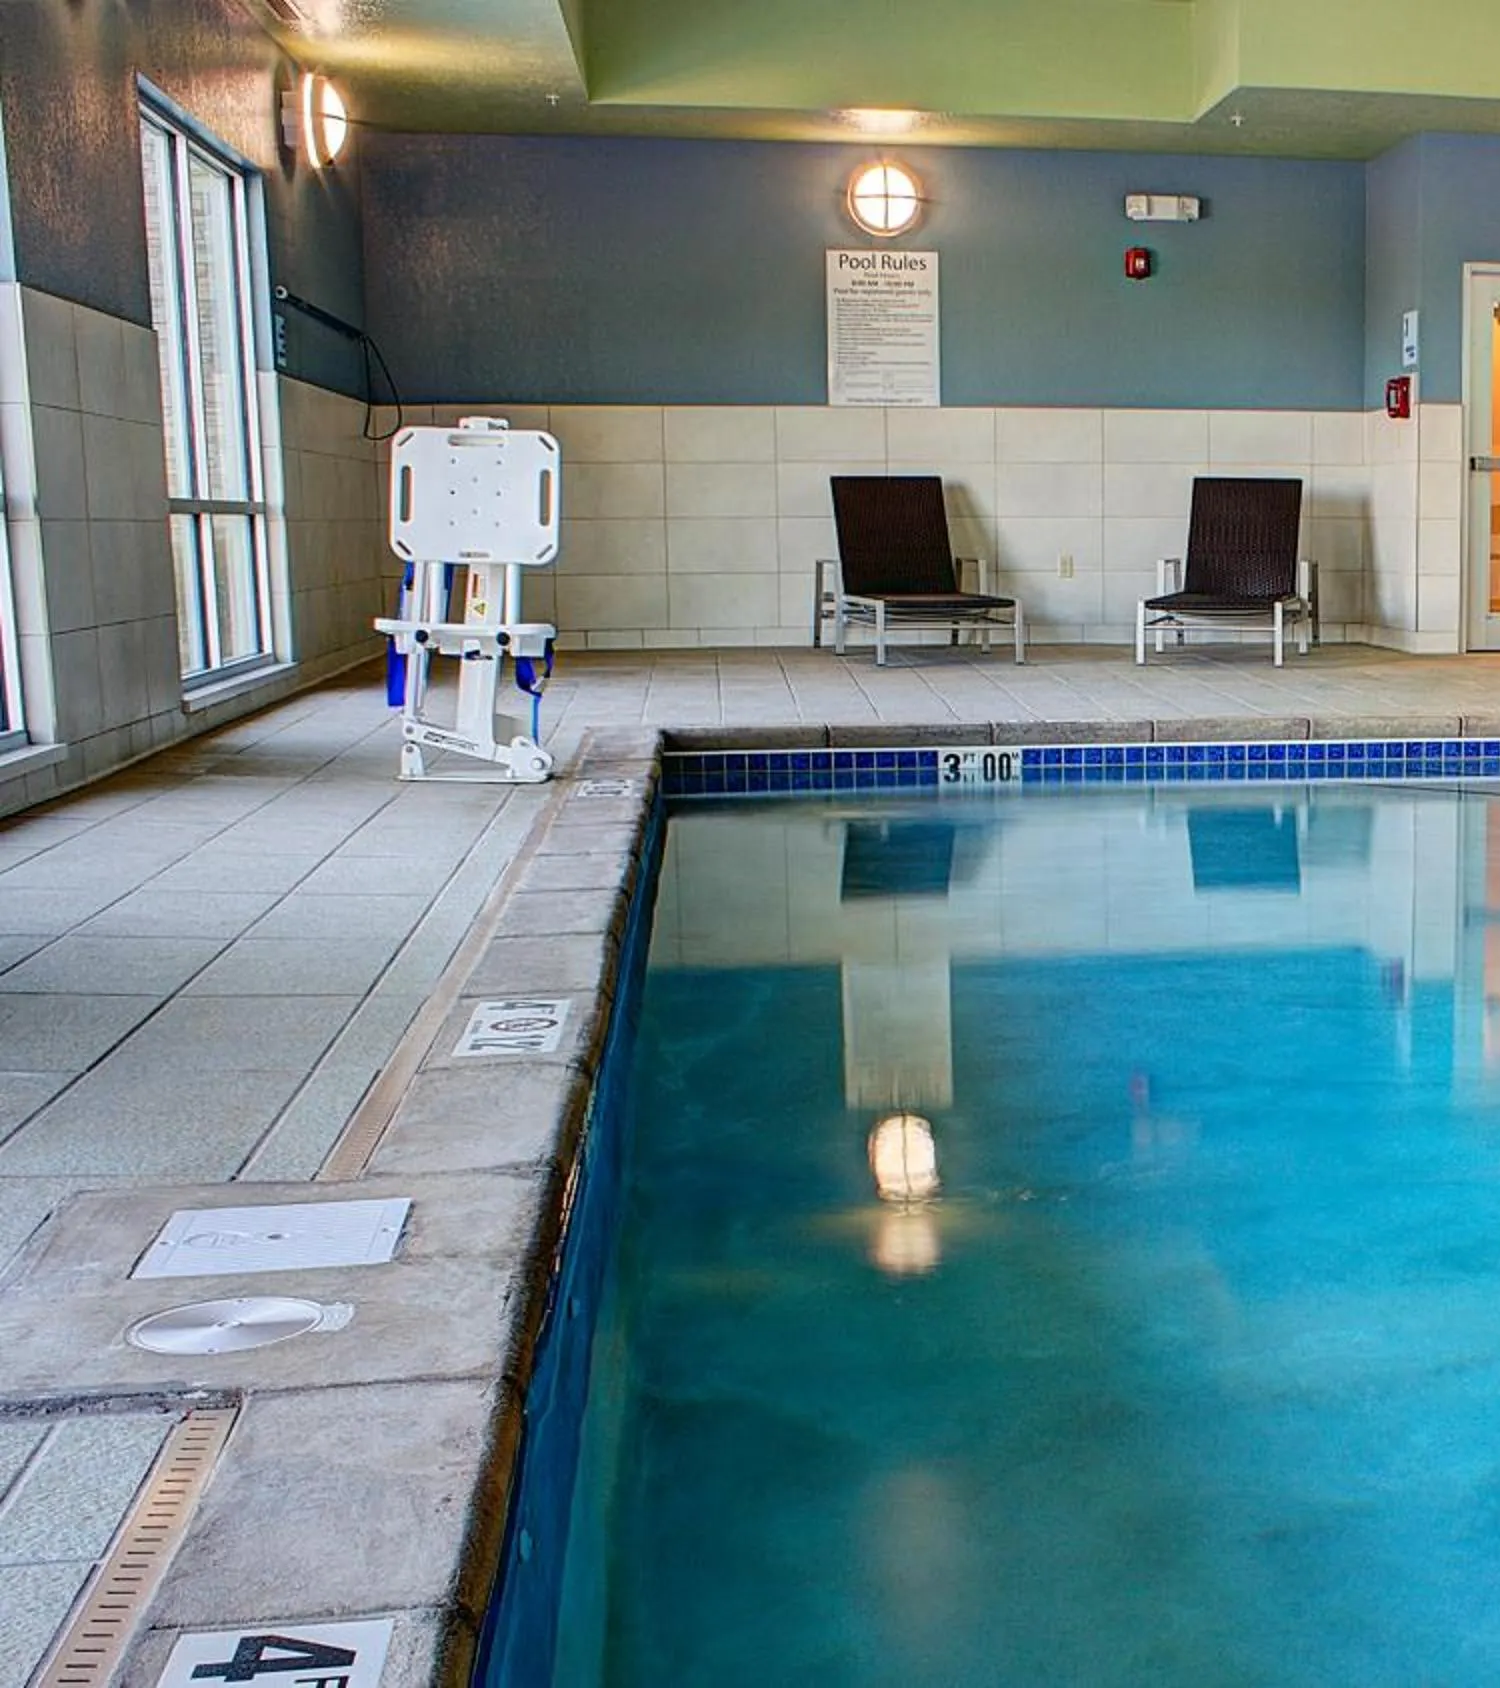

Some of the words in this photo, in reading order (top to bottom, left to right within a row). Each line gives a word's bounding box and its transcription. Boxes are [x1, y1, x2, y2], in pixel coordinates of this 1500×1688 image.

[839, 253, 877, 270] Pool
[881, 254, 928, 271] Rules
[943, 753, 961, 782] 3
[190, 1634, 357, 1682] 4
